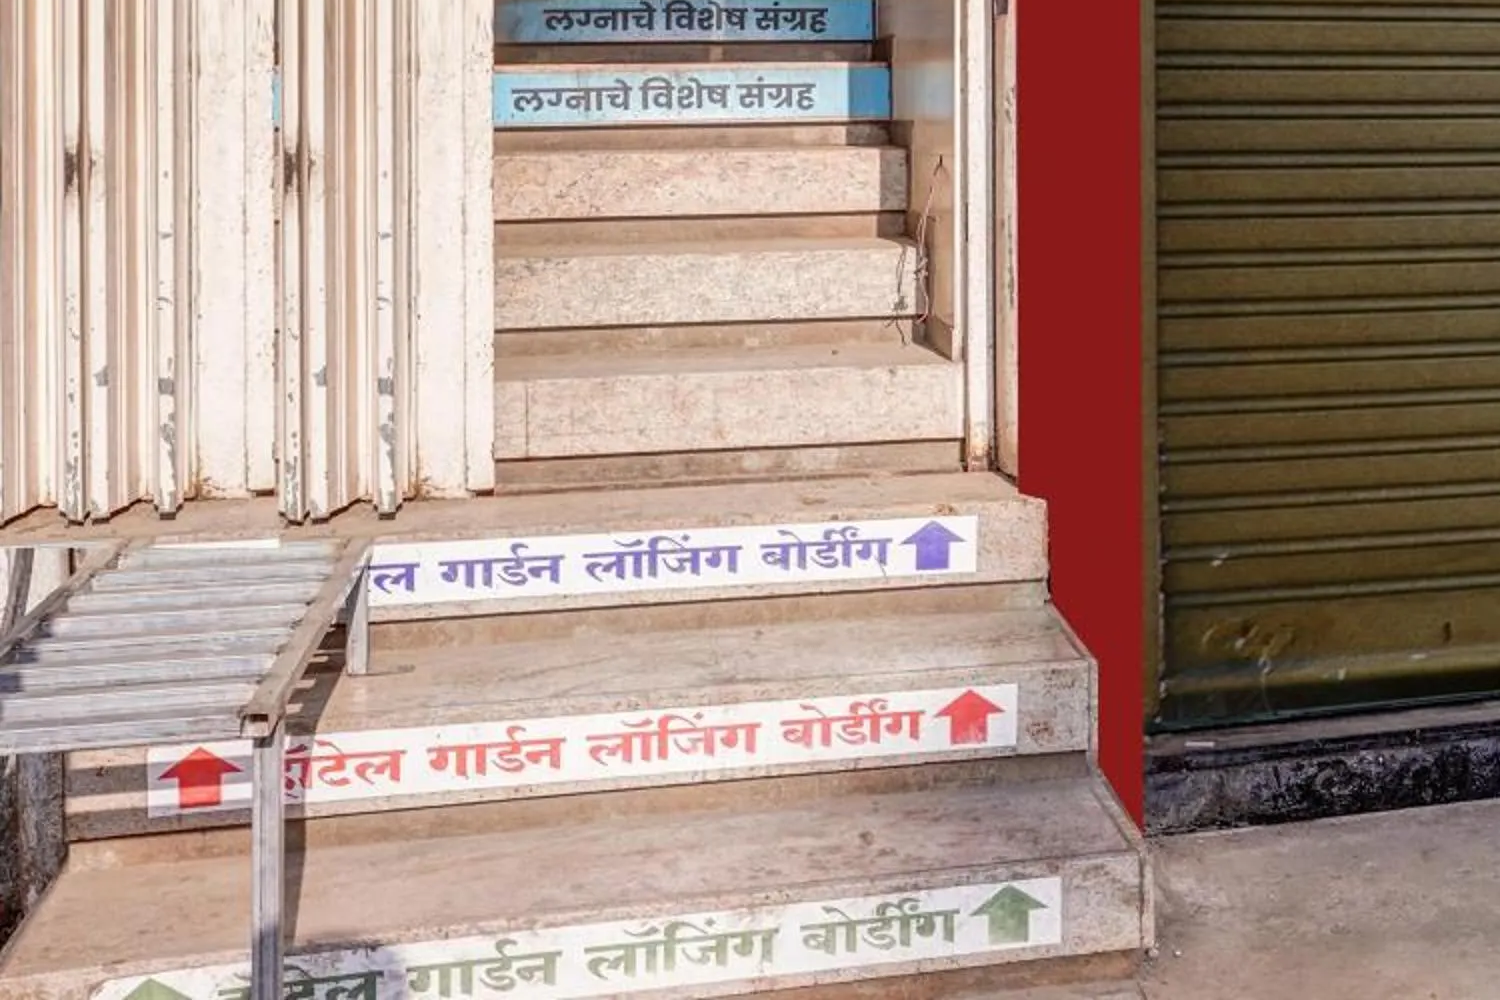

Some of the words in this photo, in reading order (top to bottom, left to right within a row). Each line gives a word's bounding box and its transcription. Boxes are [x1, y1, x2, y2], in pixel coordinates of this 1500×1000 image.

[543, 0, 655, 33] लग्नाचे
[664, 0, 746, 32] विशेष
[755, 0, 828, 34] संग्रह
[512, 79, 632, 113] लग्नाचे
[640, 77, 728, 112] विशेष
[737, 76, 816, 111] संग्रह
[438, 543, 564, 588] गार्डन
[583, 534, 742, 582] लॉजिंग
[426, 726, 566, 779] गार्डन
[586, 712, 760, 767] लॉजिंग
[406, 939, 561, 998] गार्डन
[584, 918, 780, 979] लॉजिंग
